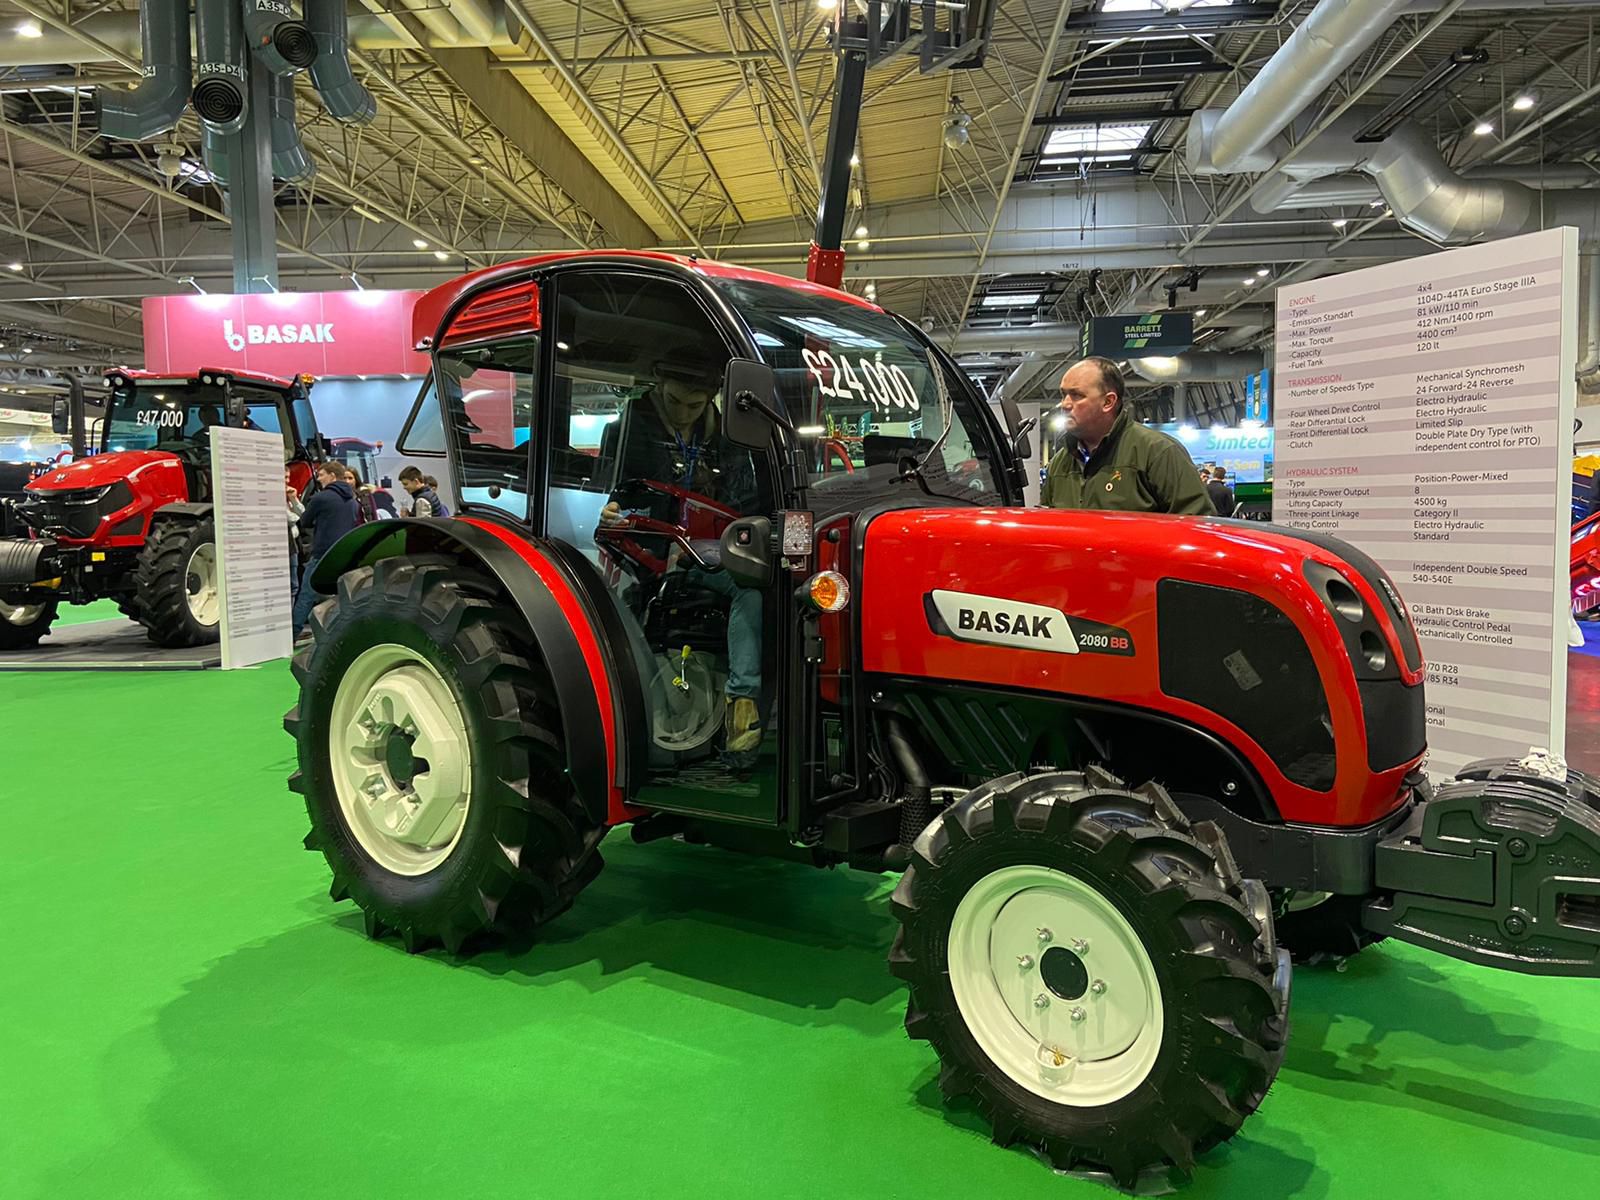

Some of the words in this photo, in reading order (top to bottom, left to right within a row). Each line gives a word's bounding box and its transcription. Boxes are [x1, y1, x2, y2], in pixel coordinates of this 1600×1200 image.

[1417, 283, 1432, 293] 4x4
[1417, 288, 1469, 305] 1104D-44TA
[1471, 285, 1492, 296] Euro
[1494, 280, 1519, 293] Stage
[1289, 294, 1317, 307] ENGINE
[1417, 308, 1427, 317] 81
[1428, 301, 1460, 315] kW/110
[1462, 299, 1479, 309] min
[1323, 310, 1354, 322] Standart
[1417, 318, 1432, 328] 412
[1434, 311, 1474, 325] Nm/1400
[1475, 310, 1494, 320] rpm
[247, 323, 335, 344] BASAK
[1124, 324, 1162, 333] BARRETT
[1309, 326, 1332, 335] Power
[1417, 329, 1439, 339] 4400
[1309, 336, 1334, 346] Torque
[1417, 342, 1432, 352] 120
[1307, 359, 1324, 367] Tank
[1416, 370, 1463, 383] Mechanical
[1465, 363, 1525, 379] Synchromesh
[802, 348, 920, 413] £24,000
[1288, 374, 1343, 388] TRANSMISSION
[1320, 386, 1328, 394] of
[1329, 383, 1356, 395] Speeds
[1357, 381, 1375, 391] Type
[1416, 386, 1426, 395] 24
[1428, 380, 1478, 394] Forward-24
[1480, 378, 1514, 388] Reverse
[1416, 396, 1445, 406] Electro
[1447, 391, 1488, 404] Hydraulic
[1307, 407, 1330, 417] Wheel
[1331, 406, 1350, 414] Drive
[1352, 402, 1381, 412] Control
[1416, 408, 1445, 418] Electro
[1446, 404, 1487, 417] Hydraulic
[136, 410, 184, 429] £47,000
[1348, 415, 1366, 423] Lock
[1415, 419, 1446, 429] Limited
[1447, 418, 1463, 428] Slip
[1310, 426, 1350, 437] Differential
[1351, 425, 1368, 434] Lock
[1415, 431, 1445, 441] Double
[1447, 429, 1468, 439] Plate
[1470, 428, 1485, 438] Dry
[1487, 426, 1508, 438] Type
[1510, 424, 1533, 435] (with
[1415, 441, 1467, 453] independent
[1469, 439, 1501, 449] control
[1503, 438, 1516, 447] for
[1518, 436, 1541, 446] PTO)
[1286, 468, 1328, 477] HYDRAULIC
[1329, 466, 1358, 475] SYSTEM
[1414, 472, 1508, 483] Position-Power-Mixed
[1319, 488, 1341, 496] Power
[1343, 488, 1370, 497] Output
[1414, 486, 1420, 495] 8
[1312, 499, 1343, 508] Capacity
[1414, 497, 1435, 506] 4500
[1437, 497, 1447, 507] kg
[1331, 510, 1360, 519] Linkage
[1414, 508, 1451, 519] Category
[1312, 520, 1339, 528] Control
[1414, 520, 1442, 529] Electro
[1444, 520, 1484, 530] Hydraulic
[1413, 531, 1450, 541] Standard
[1413, 563, 1465, 573] Independent
[1466, 564, 1498, 575] Double
[1500, 566, 1528, 577] Speed
[1413, 574, 1453, 584] 540-540E
[1412, 604, 1423, 613] Oil
[1426, 605, 1444, 615] Bath
[1446, 607, 1464, 617] Disk
[1466, 608, 1490, 618] Brake
[959, 609, 1052, 638] BASAK
[1079, 634, 1108, 648] 2080
[1110, 637, 1128, 649] BB
[1412, 616, 1450, 627] Hydraulic
[1452, 619, 1485, 630] Control
[1487, 622, 1511, 632] Pedal
[1466, 632, 1513, 645] Controlled
[1442, 664, 1459, 674] R28
[1442, 675, 1459, 685] R34
